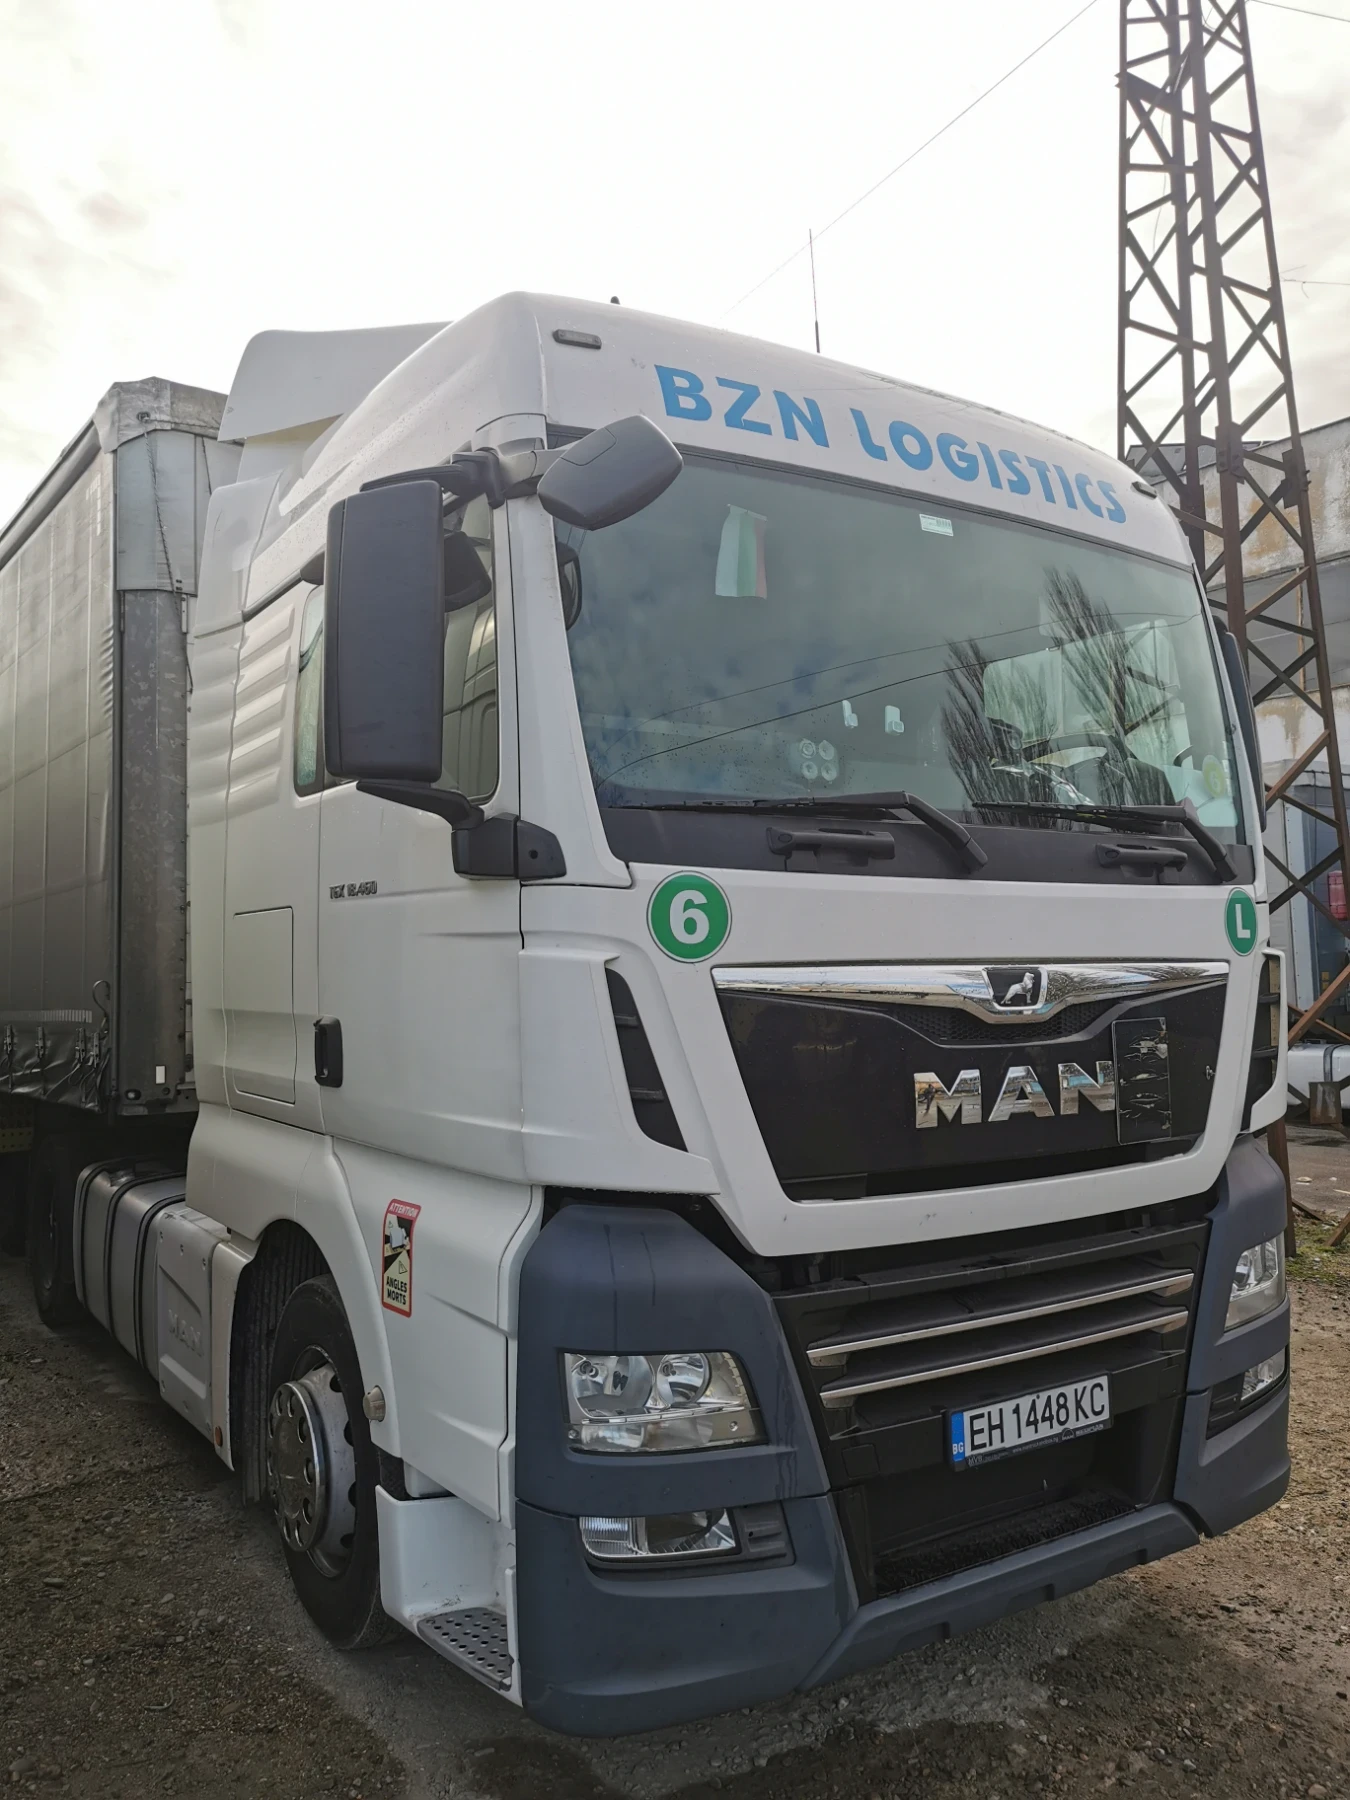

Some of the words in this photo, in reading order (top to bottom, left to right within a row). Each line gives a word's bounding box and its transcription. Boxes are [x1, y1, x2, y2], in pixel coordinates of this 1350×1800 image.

[653, 364, 830, 448] BZN
[850, 407, 1127, 524] LOGISTICS
[669, 889, 710, 944] 6
[1235, 903, 1251, 939] L
[913, 1060, 1116, 1129] MAN
[386, 1275, 408, 1294] ANGLES
[386, 1288, 407, 1306] MORTS
[952, 1442, 964, 1455] BG
[969, 1408, 1005, 1452] EH
